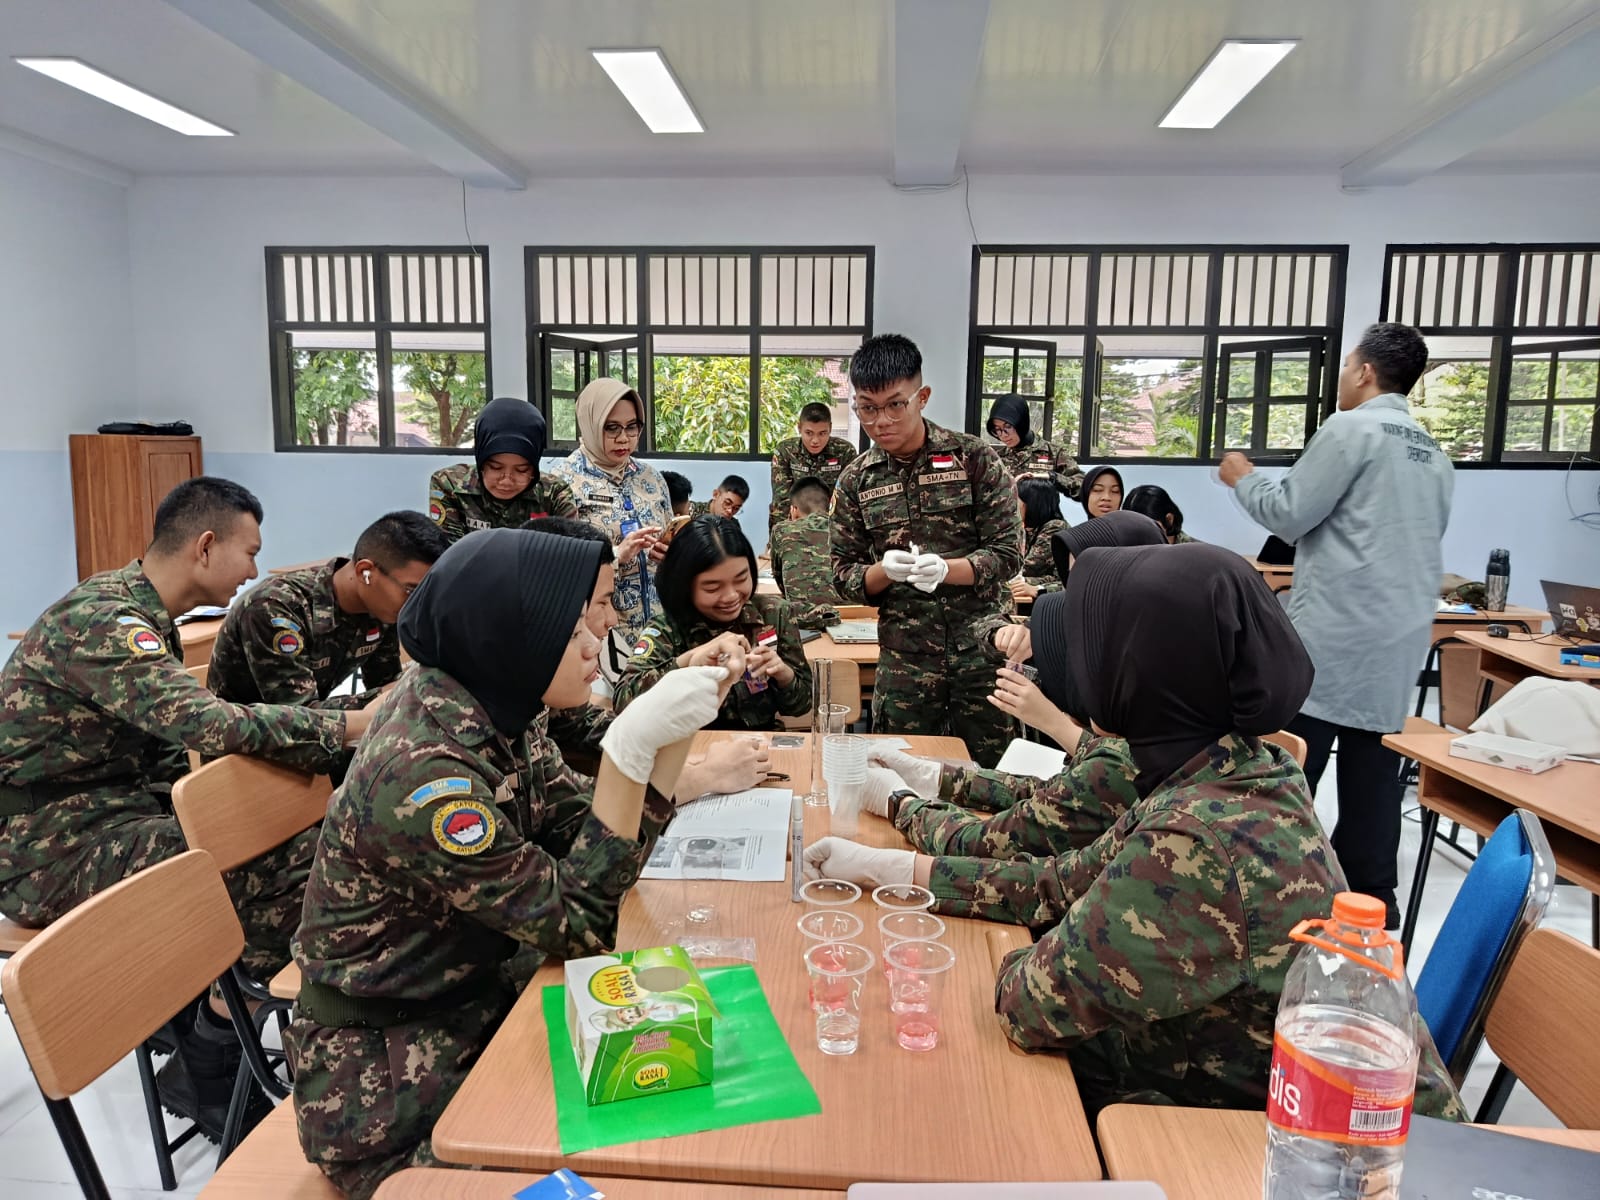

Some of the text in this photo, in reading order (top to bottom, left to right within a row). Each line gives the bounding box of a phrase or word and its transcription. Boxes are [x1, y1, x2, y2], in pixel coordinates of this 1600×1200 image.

[926, 472, 959, 483] SMA-TN
[860, 487, 886, 501] ANTONIO
[604, 977, 623, 1000] SOAL
[618, 974, 638, 998] RASA
